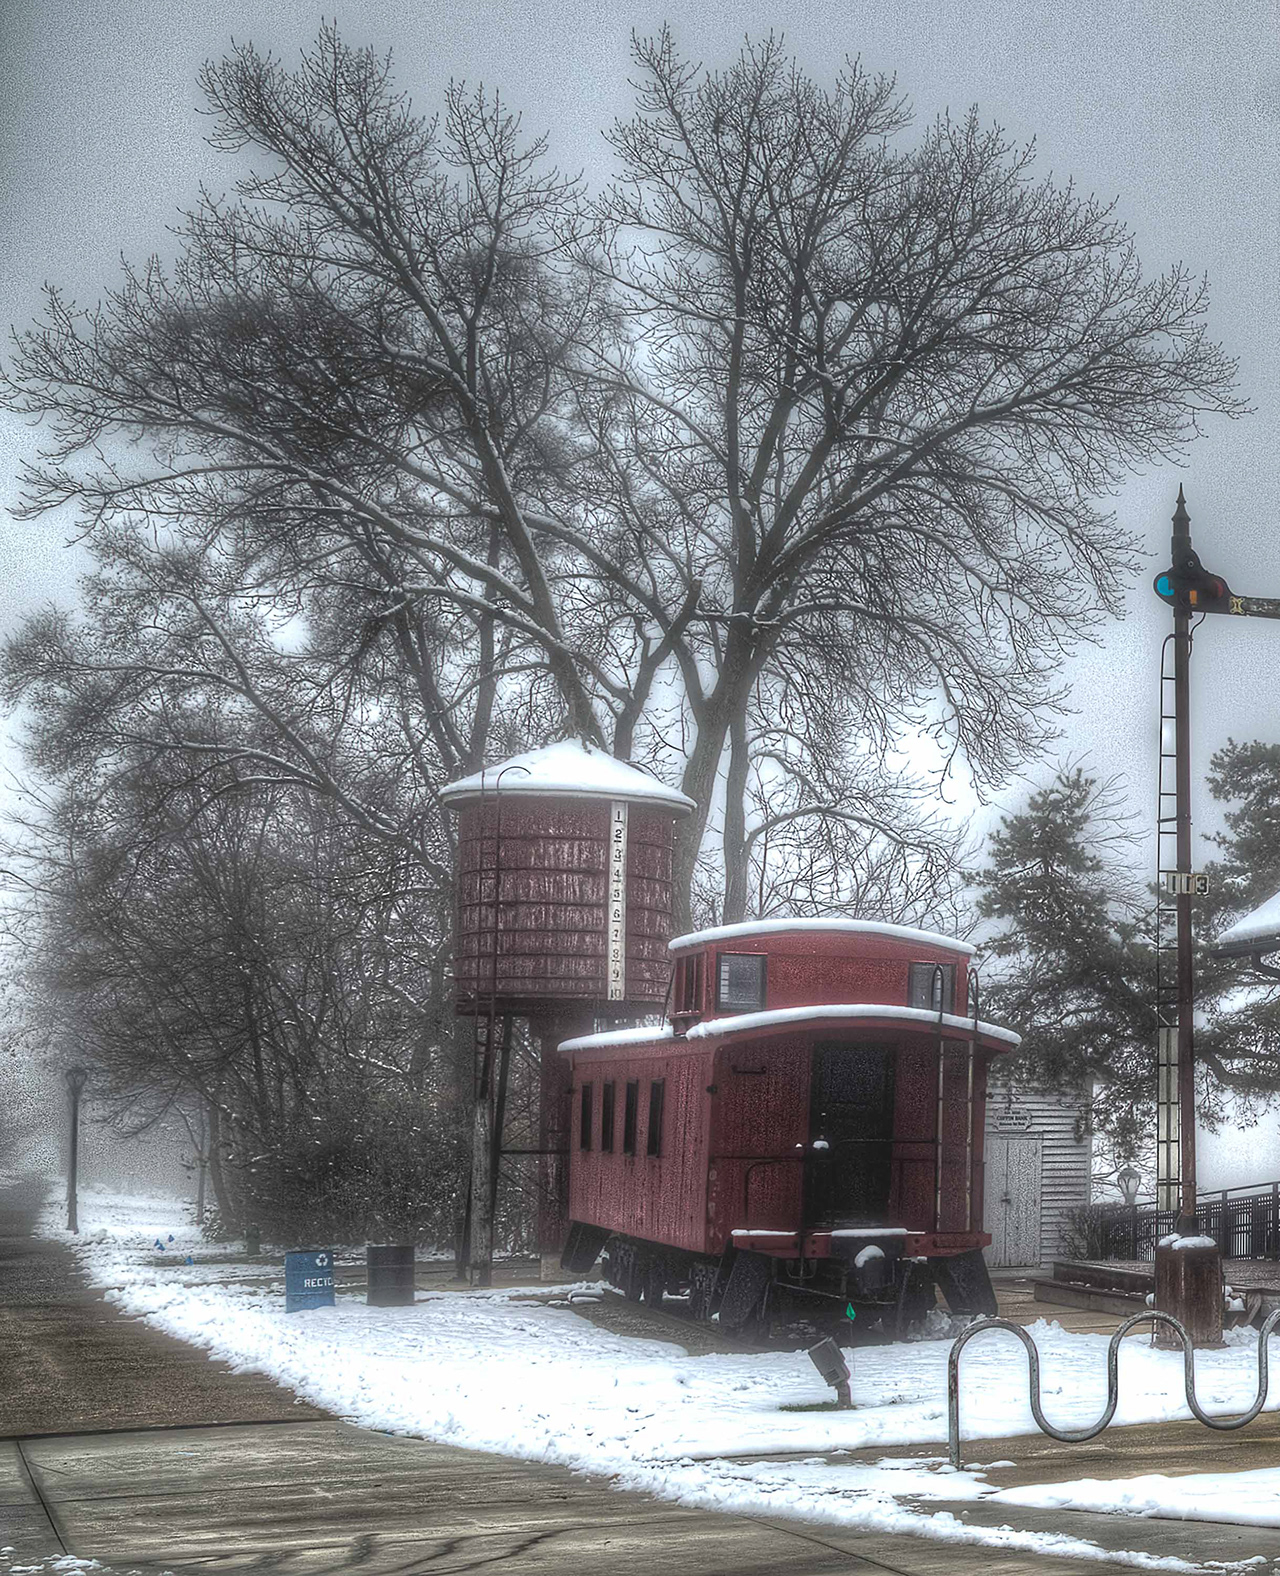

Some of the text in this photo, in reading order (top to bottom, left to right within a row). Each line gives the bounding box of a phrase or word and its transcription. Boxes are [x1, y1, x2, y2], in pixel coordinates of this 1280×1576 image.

[615, 828, 623, 839] 2
[614, 848, 622, 859] 3
[613, 869, 621, 877] 4
[1171, 875, 1207, 893] 113
[613, 889, 621, 898] 5
[613, 908, 620, 919] 6
[612, 948, 619, 959] 8
[612, 969, 620, 979] 9
[610, 988, 622, 999] 10
